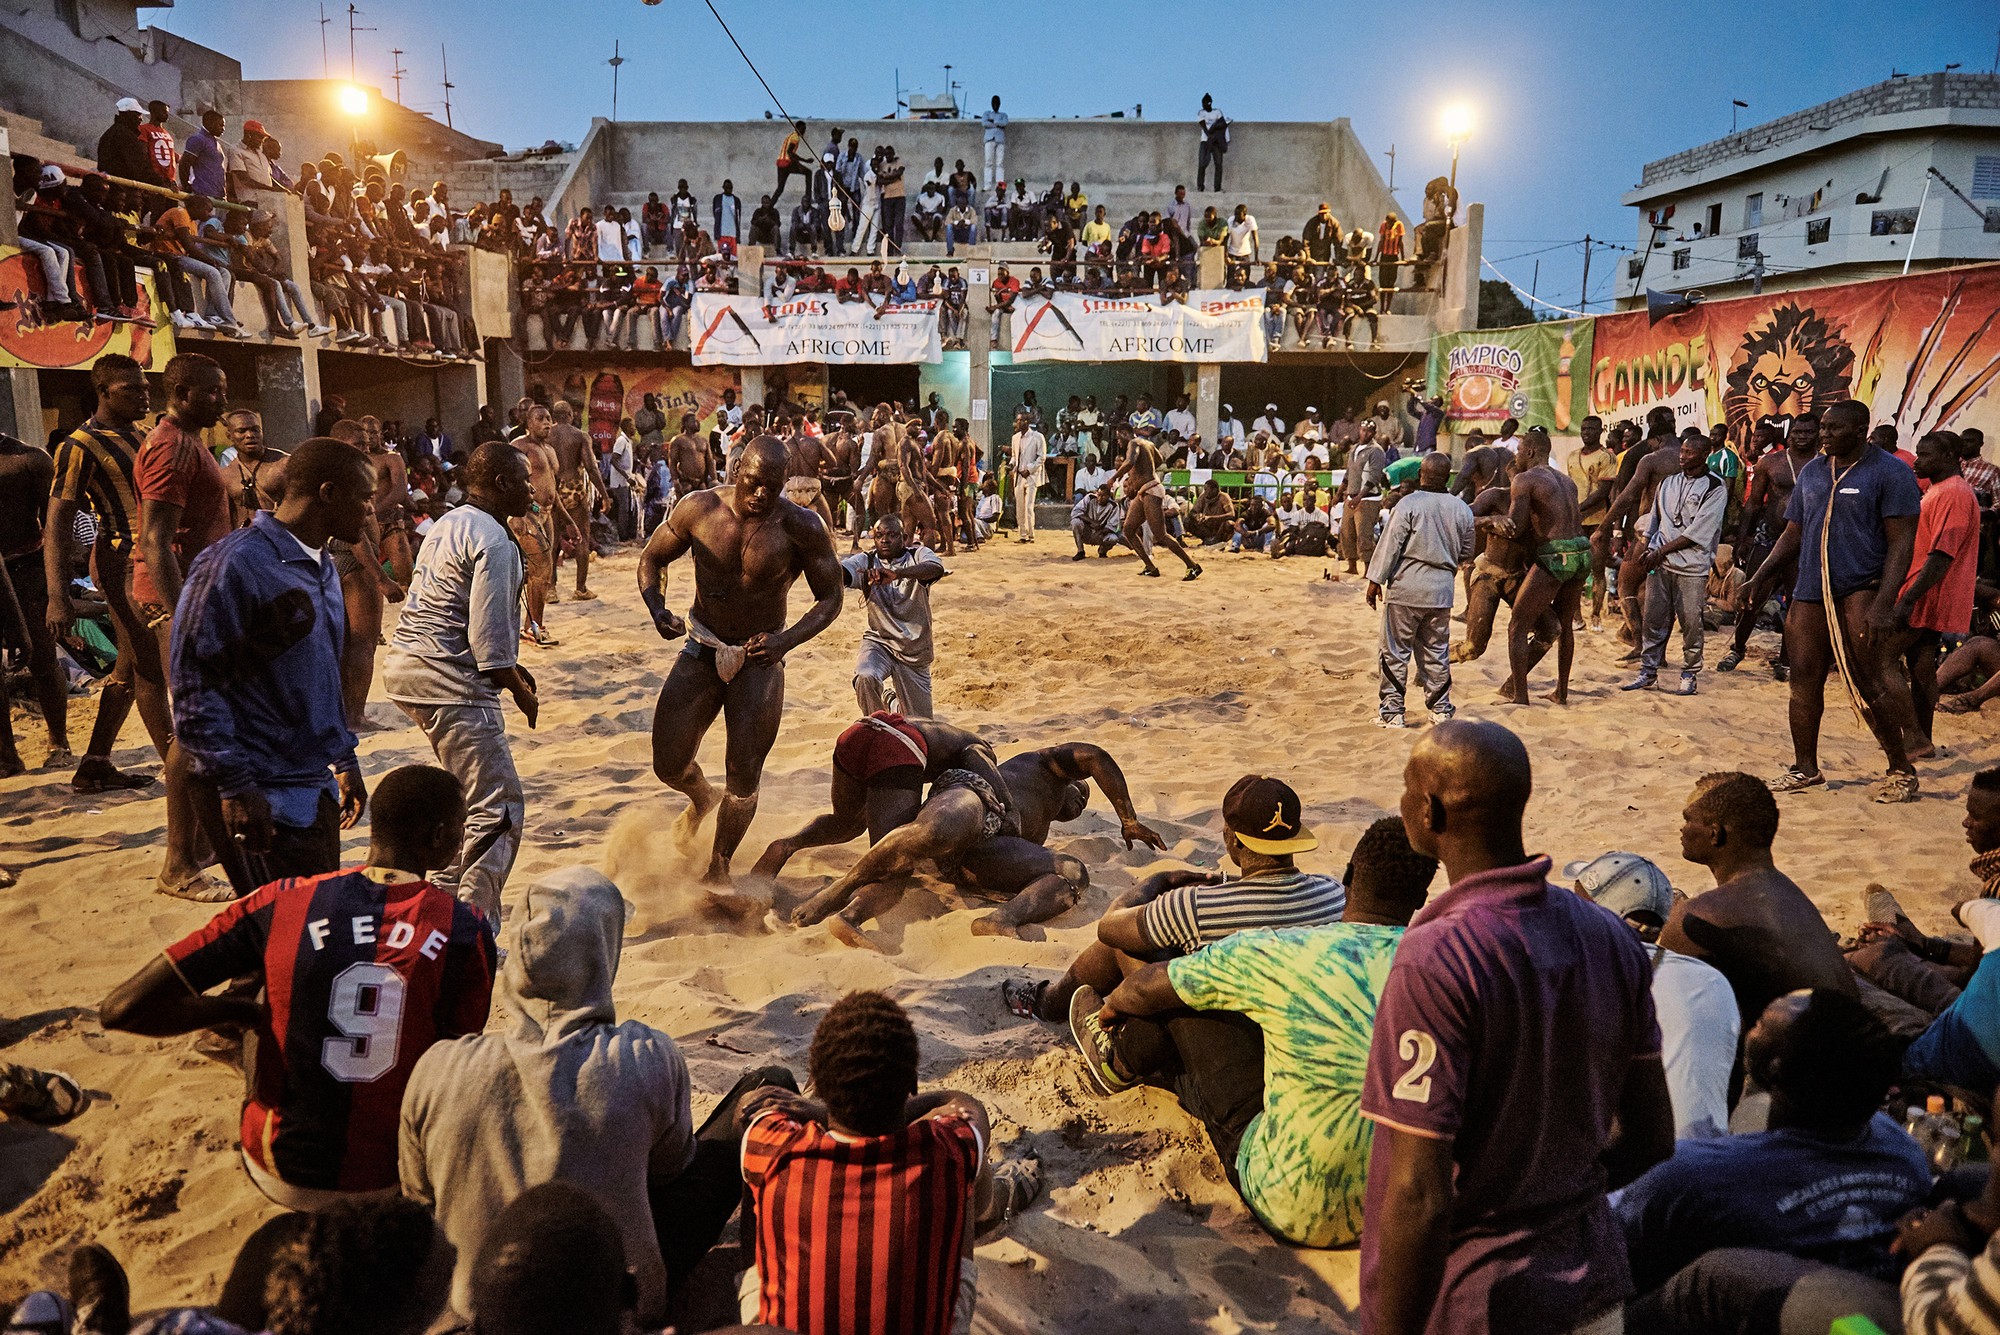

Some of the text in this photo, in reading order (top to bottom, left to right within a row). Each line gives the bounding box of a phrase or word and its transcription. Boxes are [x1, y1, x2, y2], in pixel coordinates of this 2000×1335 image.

[976, 273, 982, 282] 3
[786, 339, 891, 356] AFRICOME
[1109, 337, 1214, 354] AFRICOME
[1449, 345, 1522, 373] TAMPICO
[1677, 403, 1692, 416] TOI
[308, 915, 448, 961] FEDE
[321, 961, 408, 1083] 9
[1392, 1029, 1437, 1104] 2
